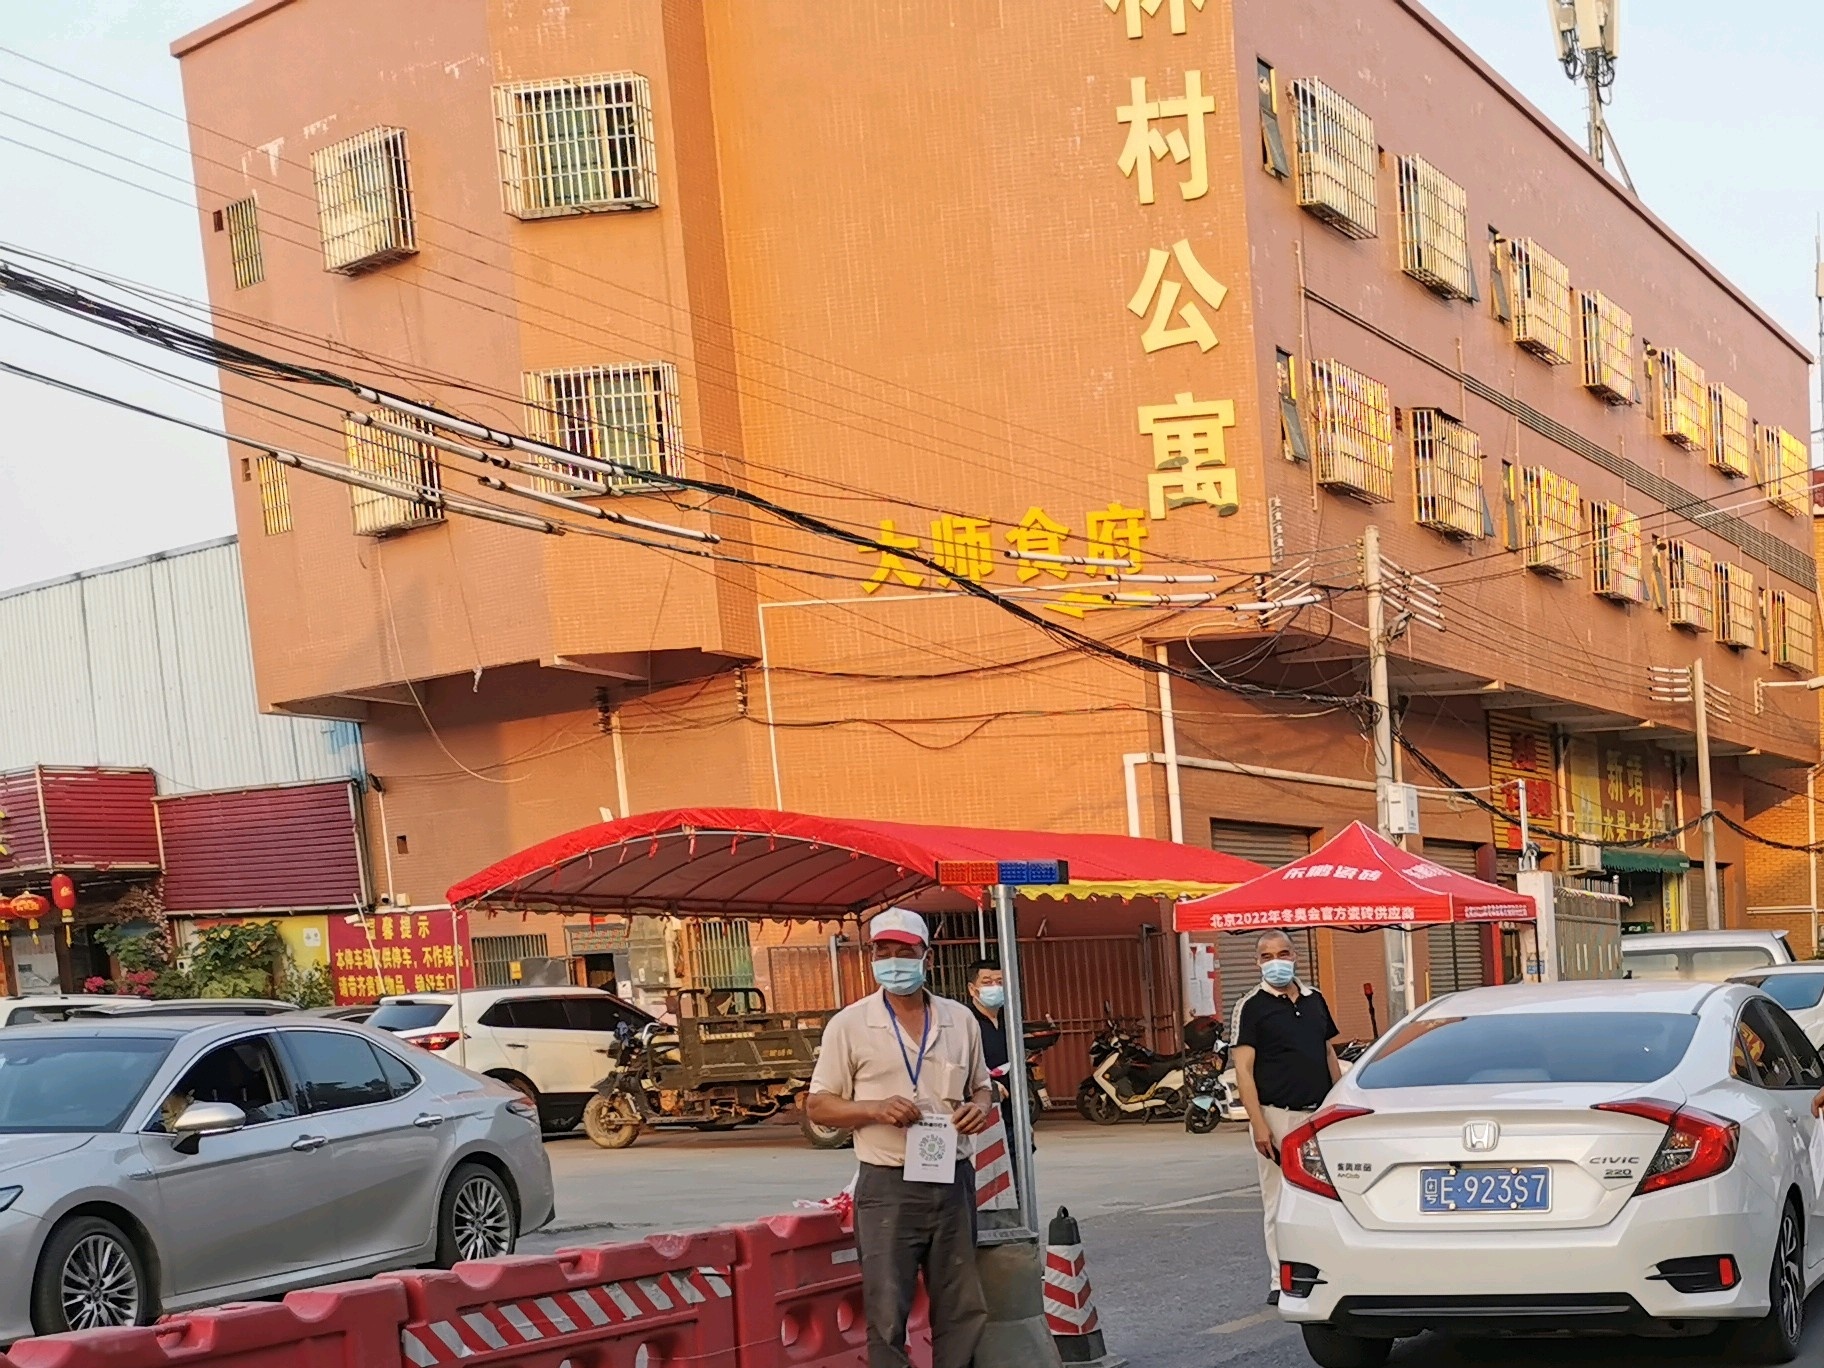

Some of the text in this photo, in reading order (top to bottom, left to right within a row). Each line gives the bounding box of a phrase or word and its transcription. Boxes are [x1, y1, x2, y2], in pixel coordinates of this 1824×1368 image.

[857, 501, 1149, 594] 大师食府
[1282, 864, 1383, 881] 东鹏瓷砖
[1210, 906, 1415, 928] 北京2022年冬奥会官方瓷砖供应商
[1589, 1156, 1640, 1165] CIVIC
[1604, 1168, 1632, 1176] 220
